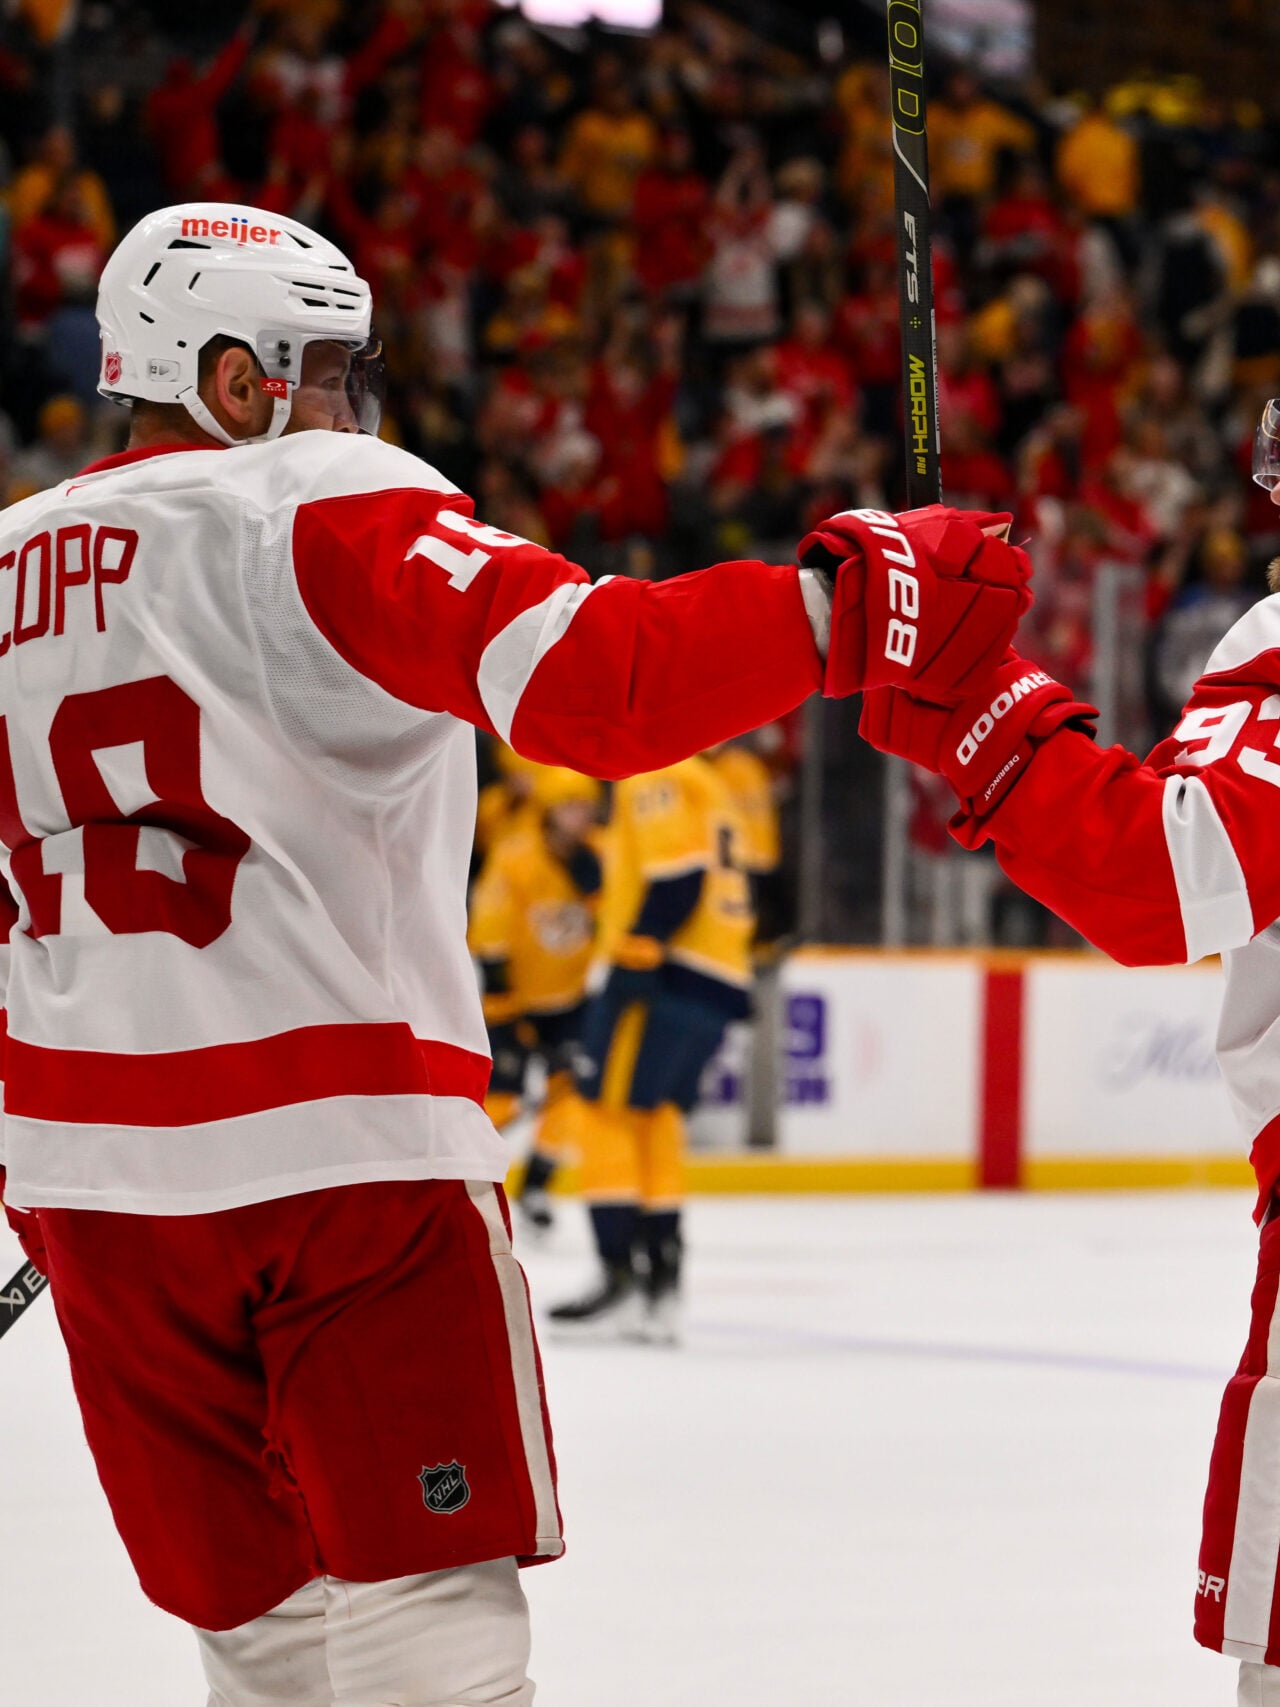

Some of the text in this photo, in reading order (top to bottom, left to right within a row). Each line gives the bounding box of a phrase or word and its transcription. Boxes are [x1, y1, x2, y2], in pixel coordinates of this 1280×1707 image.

[181, 217, 282, 247] meijer
[904, 211, 919, 304] ETS
[909, 353, 928, 453] MORPH
[403, 509, 548, 593] 18
[984, 754, 1020, 801] DEBRINCAT
[432, 1474, 459, 1505] NHL
